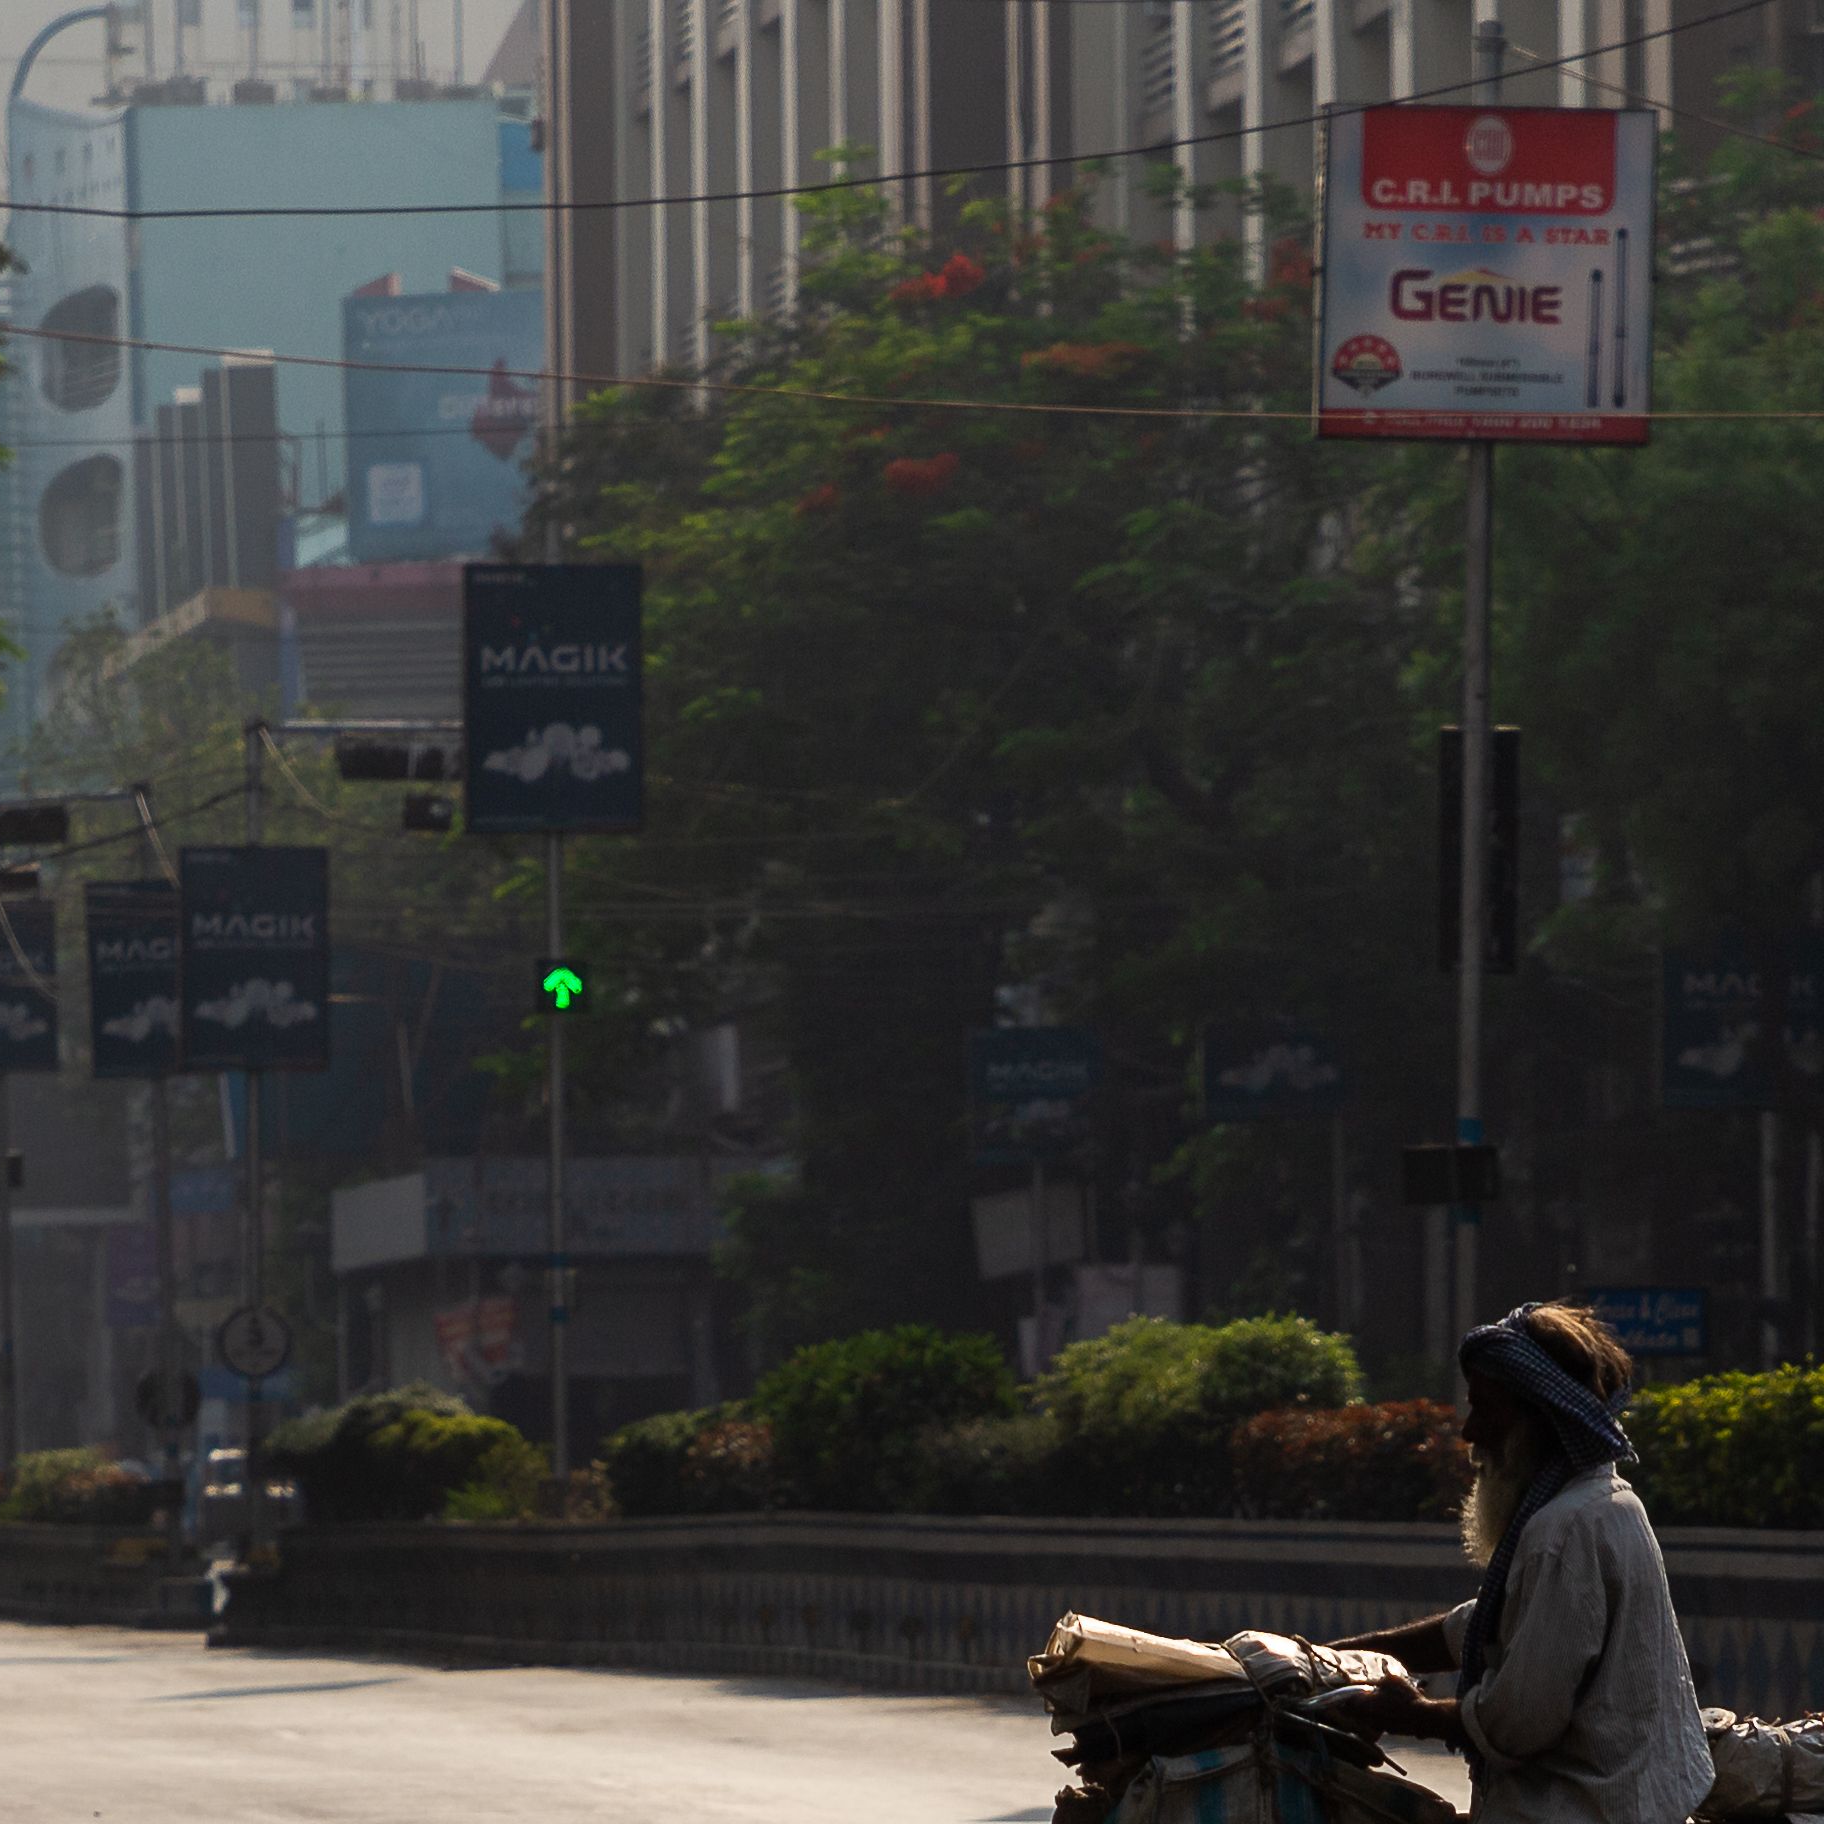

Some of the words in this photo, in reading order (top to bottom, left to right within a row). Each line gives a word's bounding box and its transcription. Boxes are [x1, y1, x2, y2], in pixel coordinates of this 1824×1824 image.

[1469, 182, 1605, 210] PUMPS
[1363, 221, 1402, 240] MY
[1516, 226, 1536, 243] A
[1543, 227, 1610, 245] STAR
[480, 643, 629, 672] MAGIK
[192, 912, 318, 937] MAGIK
